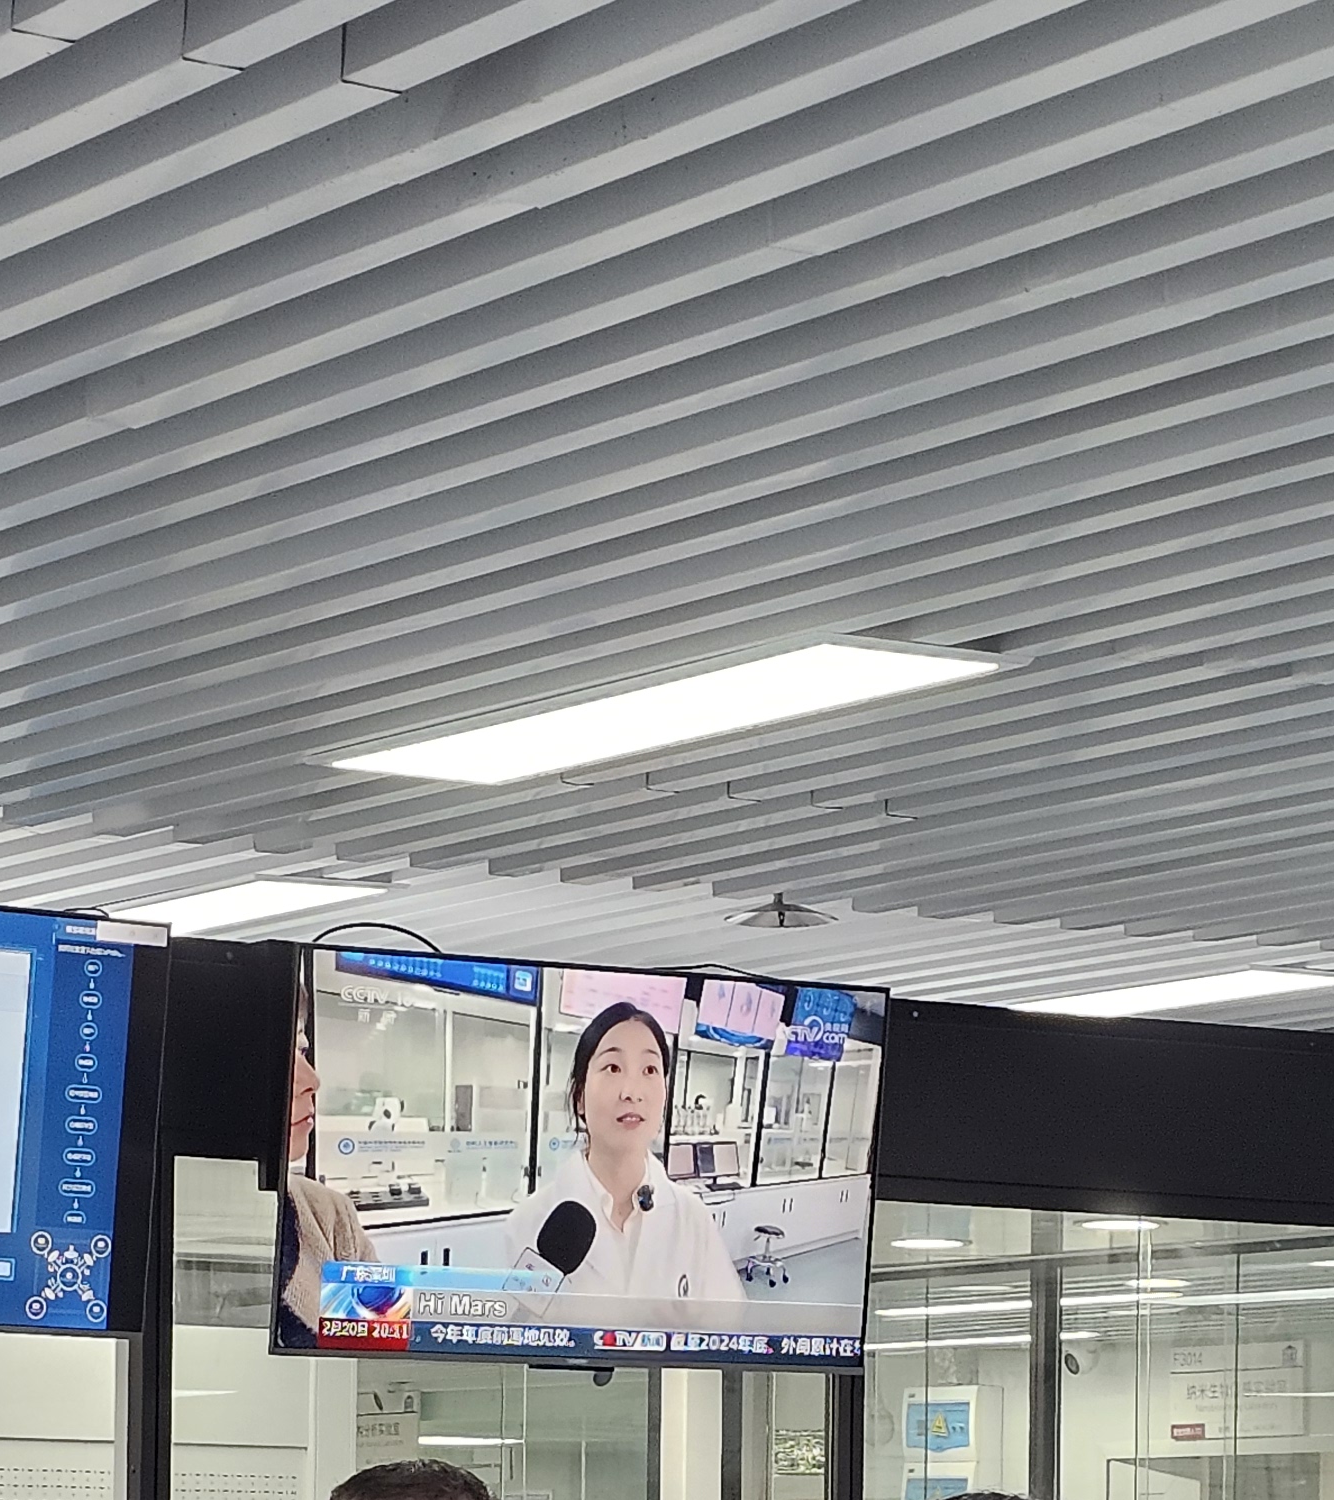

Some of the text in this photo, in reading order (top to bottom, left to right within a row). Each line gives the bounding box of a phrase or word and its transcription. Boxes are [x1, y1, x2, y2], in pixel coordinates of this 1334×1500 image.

[341, 1265, 396, 1283] 广东深圳
[418, 1292, 508, 1318] Hi Mars
